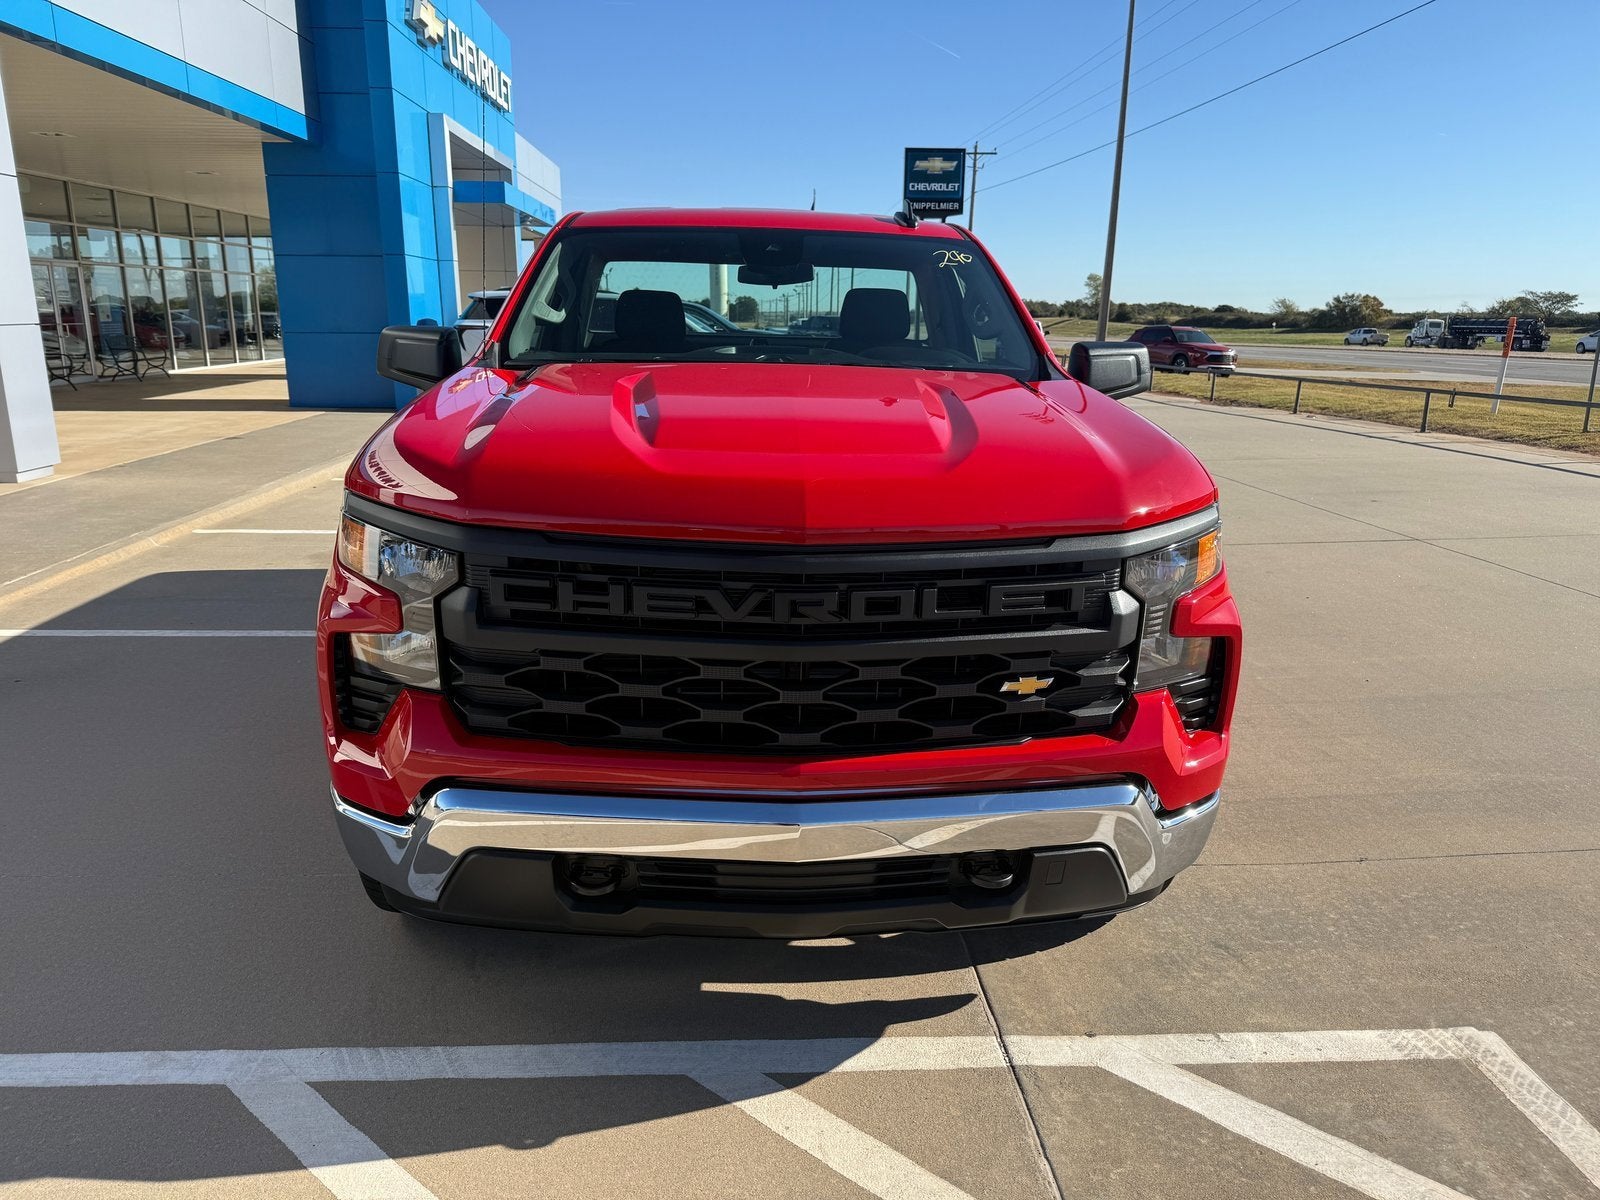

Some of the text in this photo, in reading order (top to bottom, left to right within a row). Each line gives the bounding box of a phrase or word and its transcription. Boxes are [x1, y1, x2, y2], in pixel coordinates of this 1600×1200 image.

[447, 18, 512, 113] CHEVROLET
[908, 182, 960, 192] CHEVROLET
[911, 202, 960, 210] NIPPELMIER
[489, 570, 1105, 624] CHEVROLET
